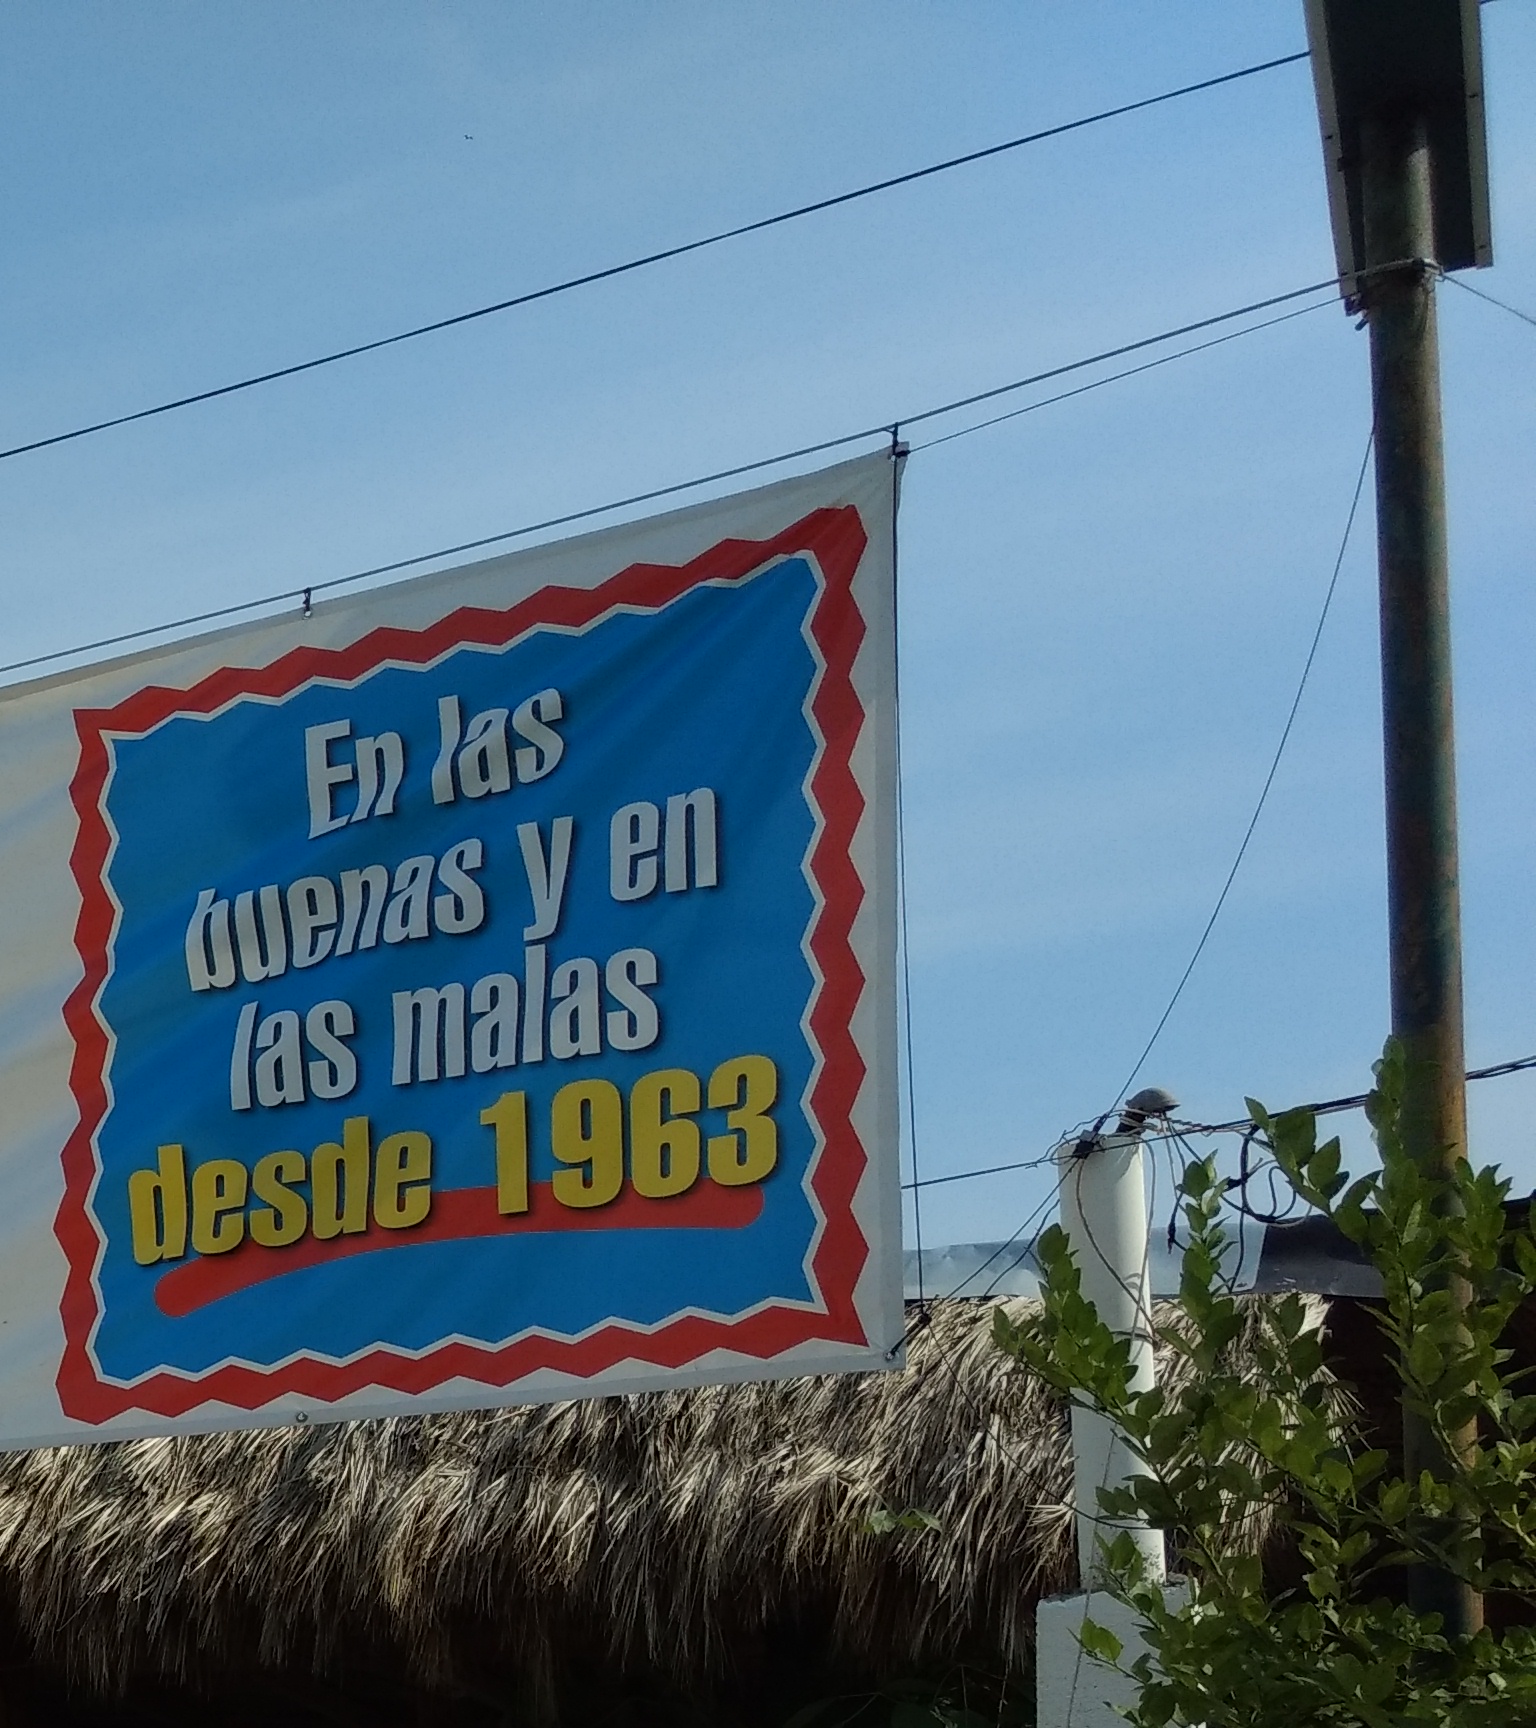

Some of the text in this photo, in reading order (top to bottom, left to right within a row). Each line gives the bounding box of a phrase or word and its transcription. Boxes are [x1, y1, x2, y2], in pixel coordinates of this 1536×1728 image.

[305, 687, 567, 840] En las
[184, 786, 719, 993] buenas y en
[230, 942, 660, 1111] las malas
[129, 1052, 779, 1266] desde 1963
